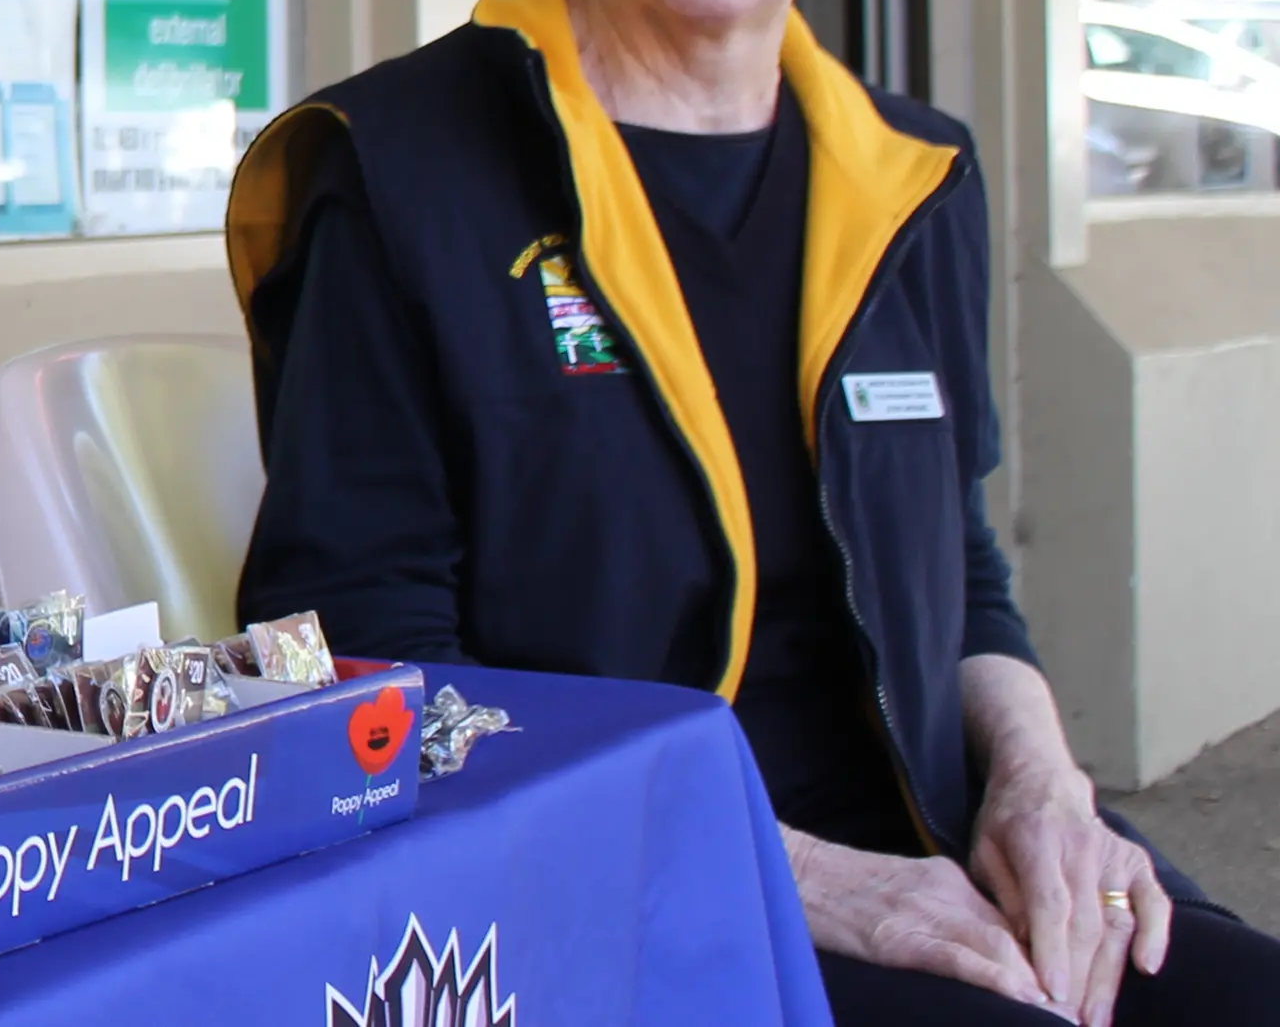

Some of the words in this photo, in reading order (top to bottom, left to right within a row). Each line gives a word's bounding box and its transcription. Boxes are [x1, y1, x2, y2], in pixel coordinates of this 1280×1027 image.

[148, 14, 227, 47] external
[184, 658, 206, 685] $20
[331, 793, 363, 816] Poppy
[363, 778, 400, 807] Appeal
[86, 752, 259, 882] Appeal
